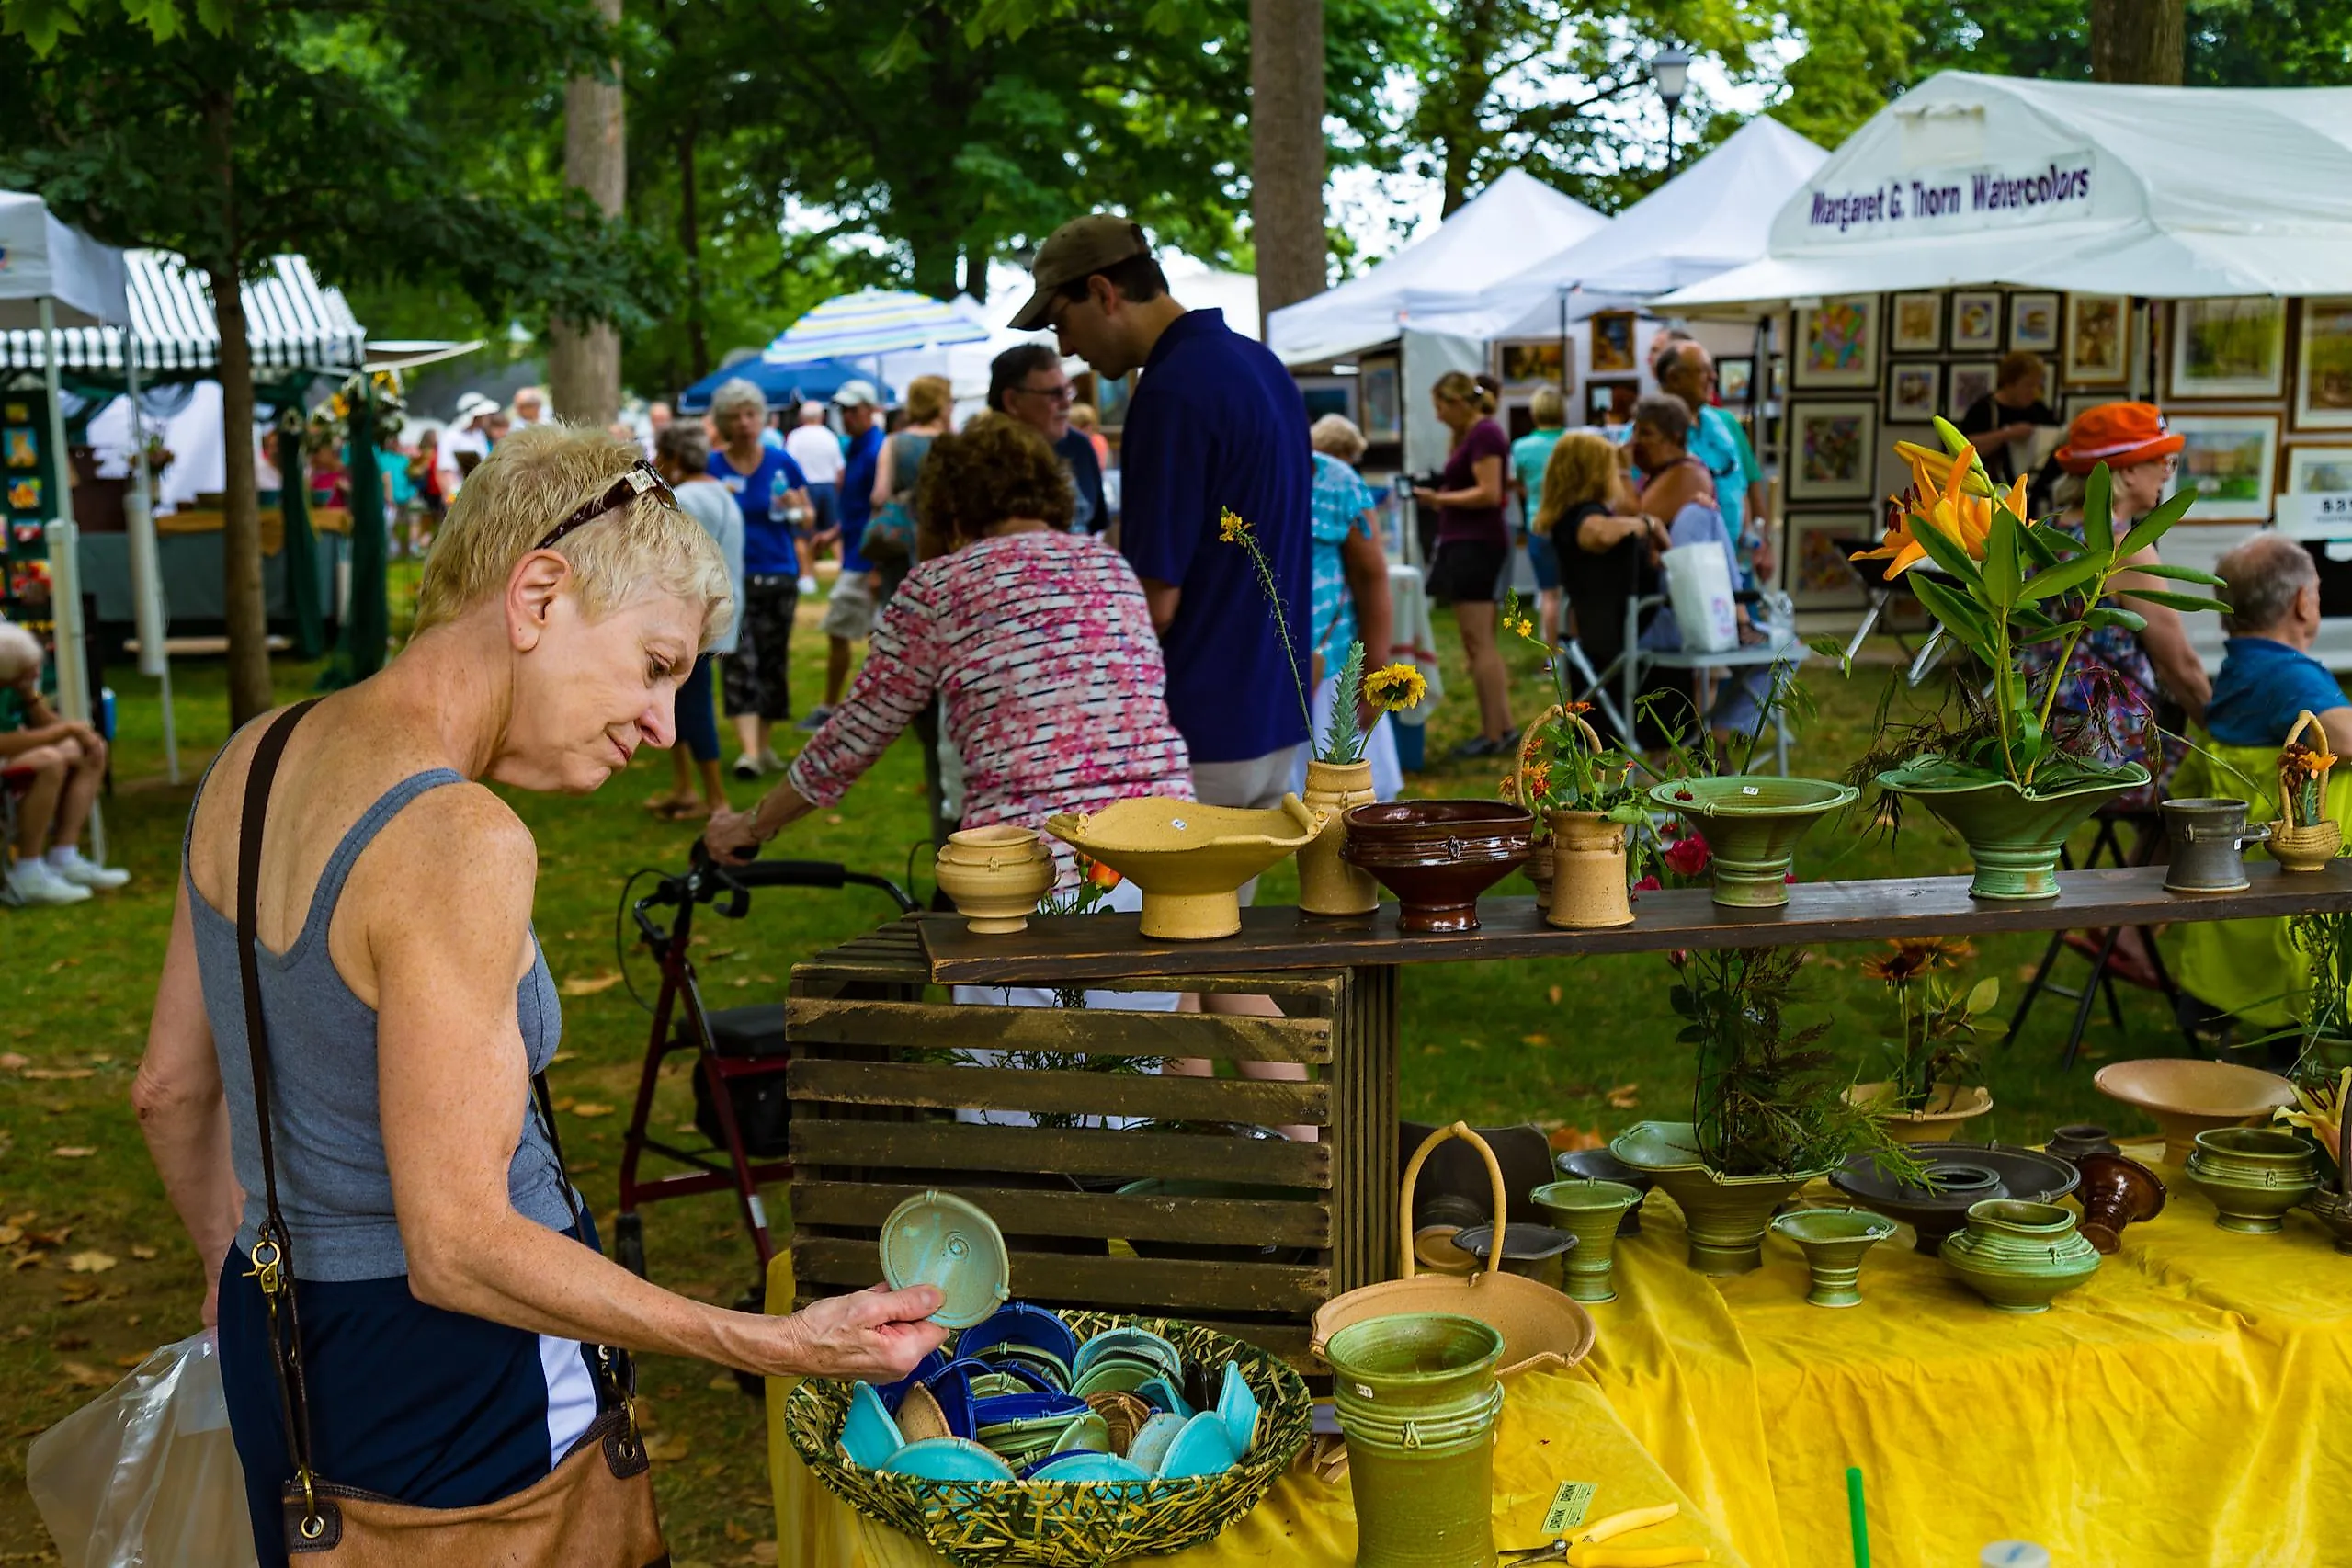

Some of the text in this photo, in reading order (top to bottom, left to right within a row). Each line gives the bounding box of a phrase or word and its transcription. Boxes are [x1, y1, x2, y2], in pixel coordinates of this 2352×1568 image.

[1811, 187, 1884, 233] Margaret
[1911, 180, 1960, 218] Thorn
[1972, 164, 2089, 210] Watercolors
[1549, 1508, 1566, 1528] DRINK
[1560, 1484, 1577, 1501] DRINK
